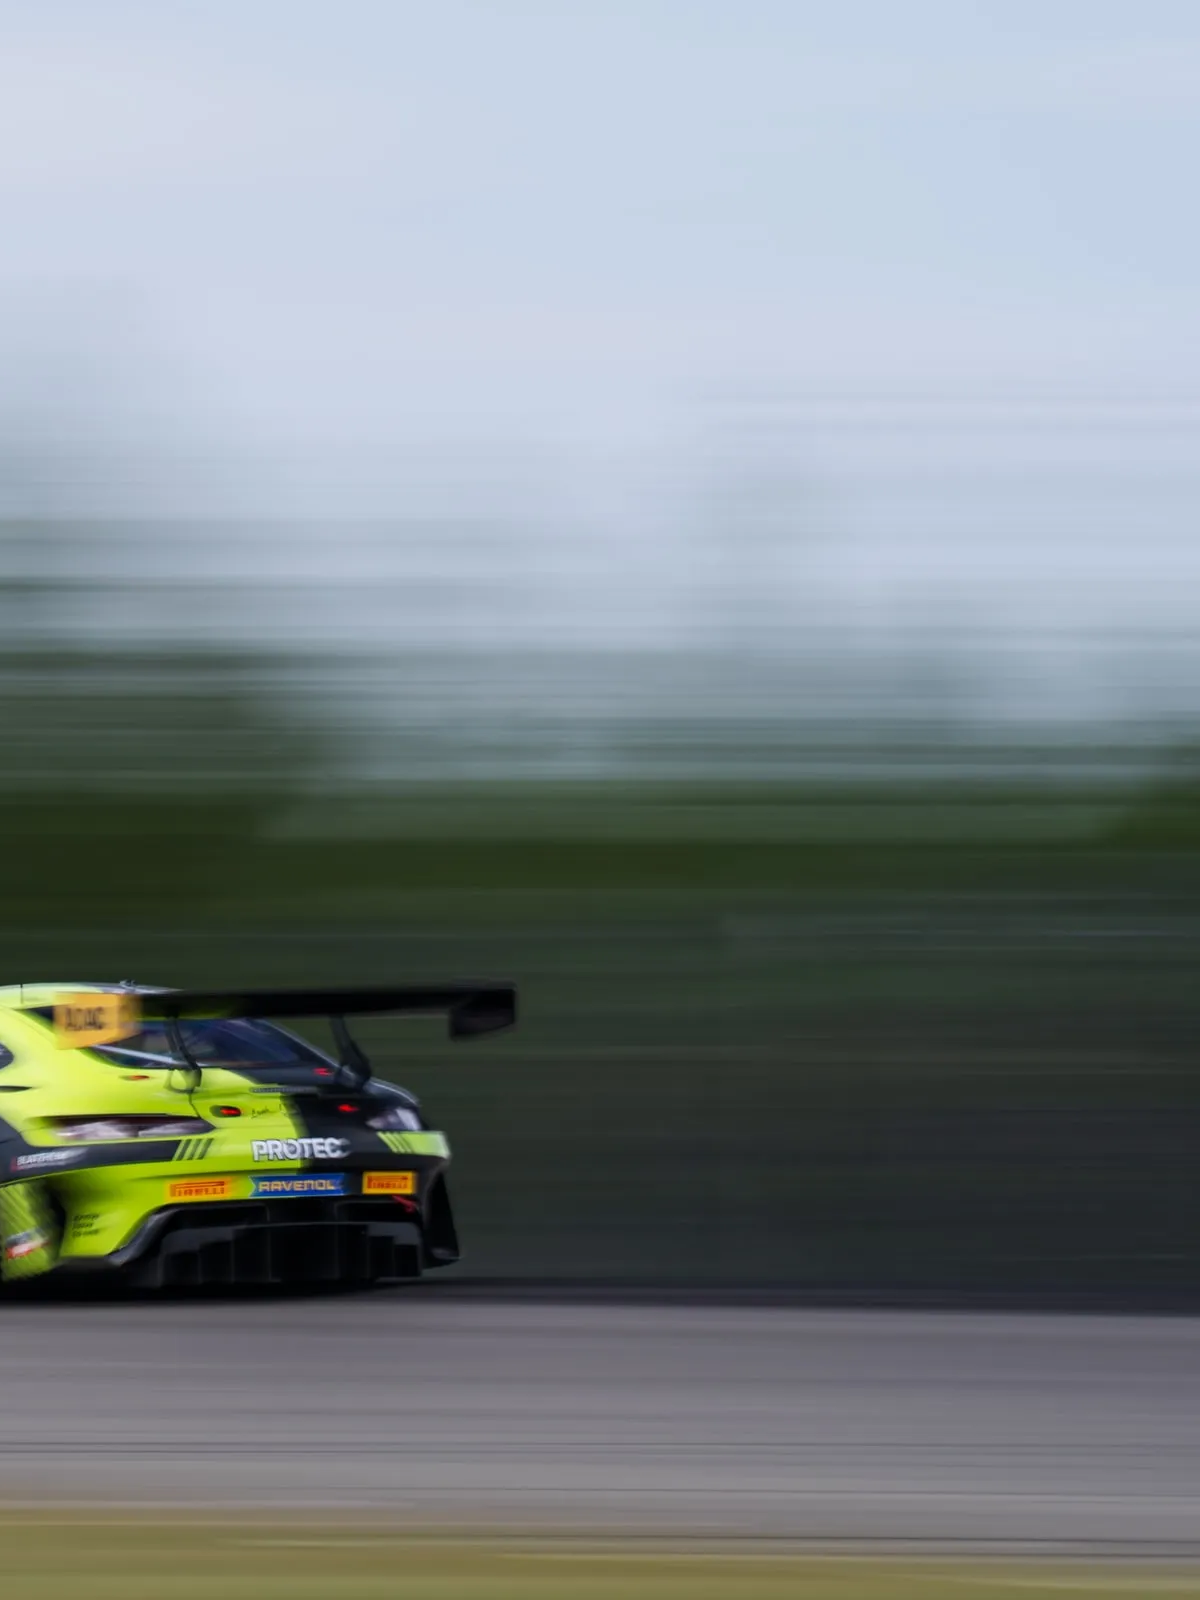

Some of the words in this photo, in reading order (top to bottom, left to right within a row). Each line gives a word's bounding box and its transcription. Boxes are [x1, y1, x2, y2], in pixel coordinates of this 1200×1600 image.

[252, 1137, 346, 1162] PROTEC
[170, 1181, 225, 1197] PIRELLI
[258, 1179, 336, 1192] RAVENOL
[367, 1175, 409, 1189] PIRELLI
